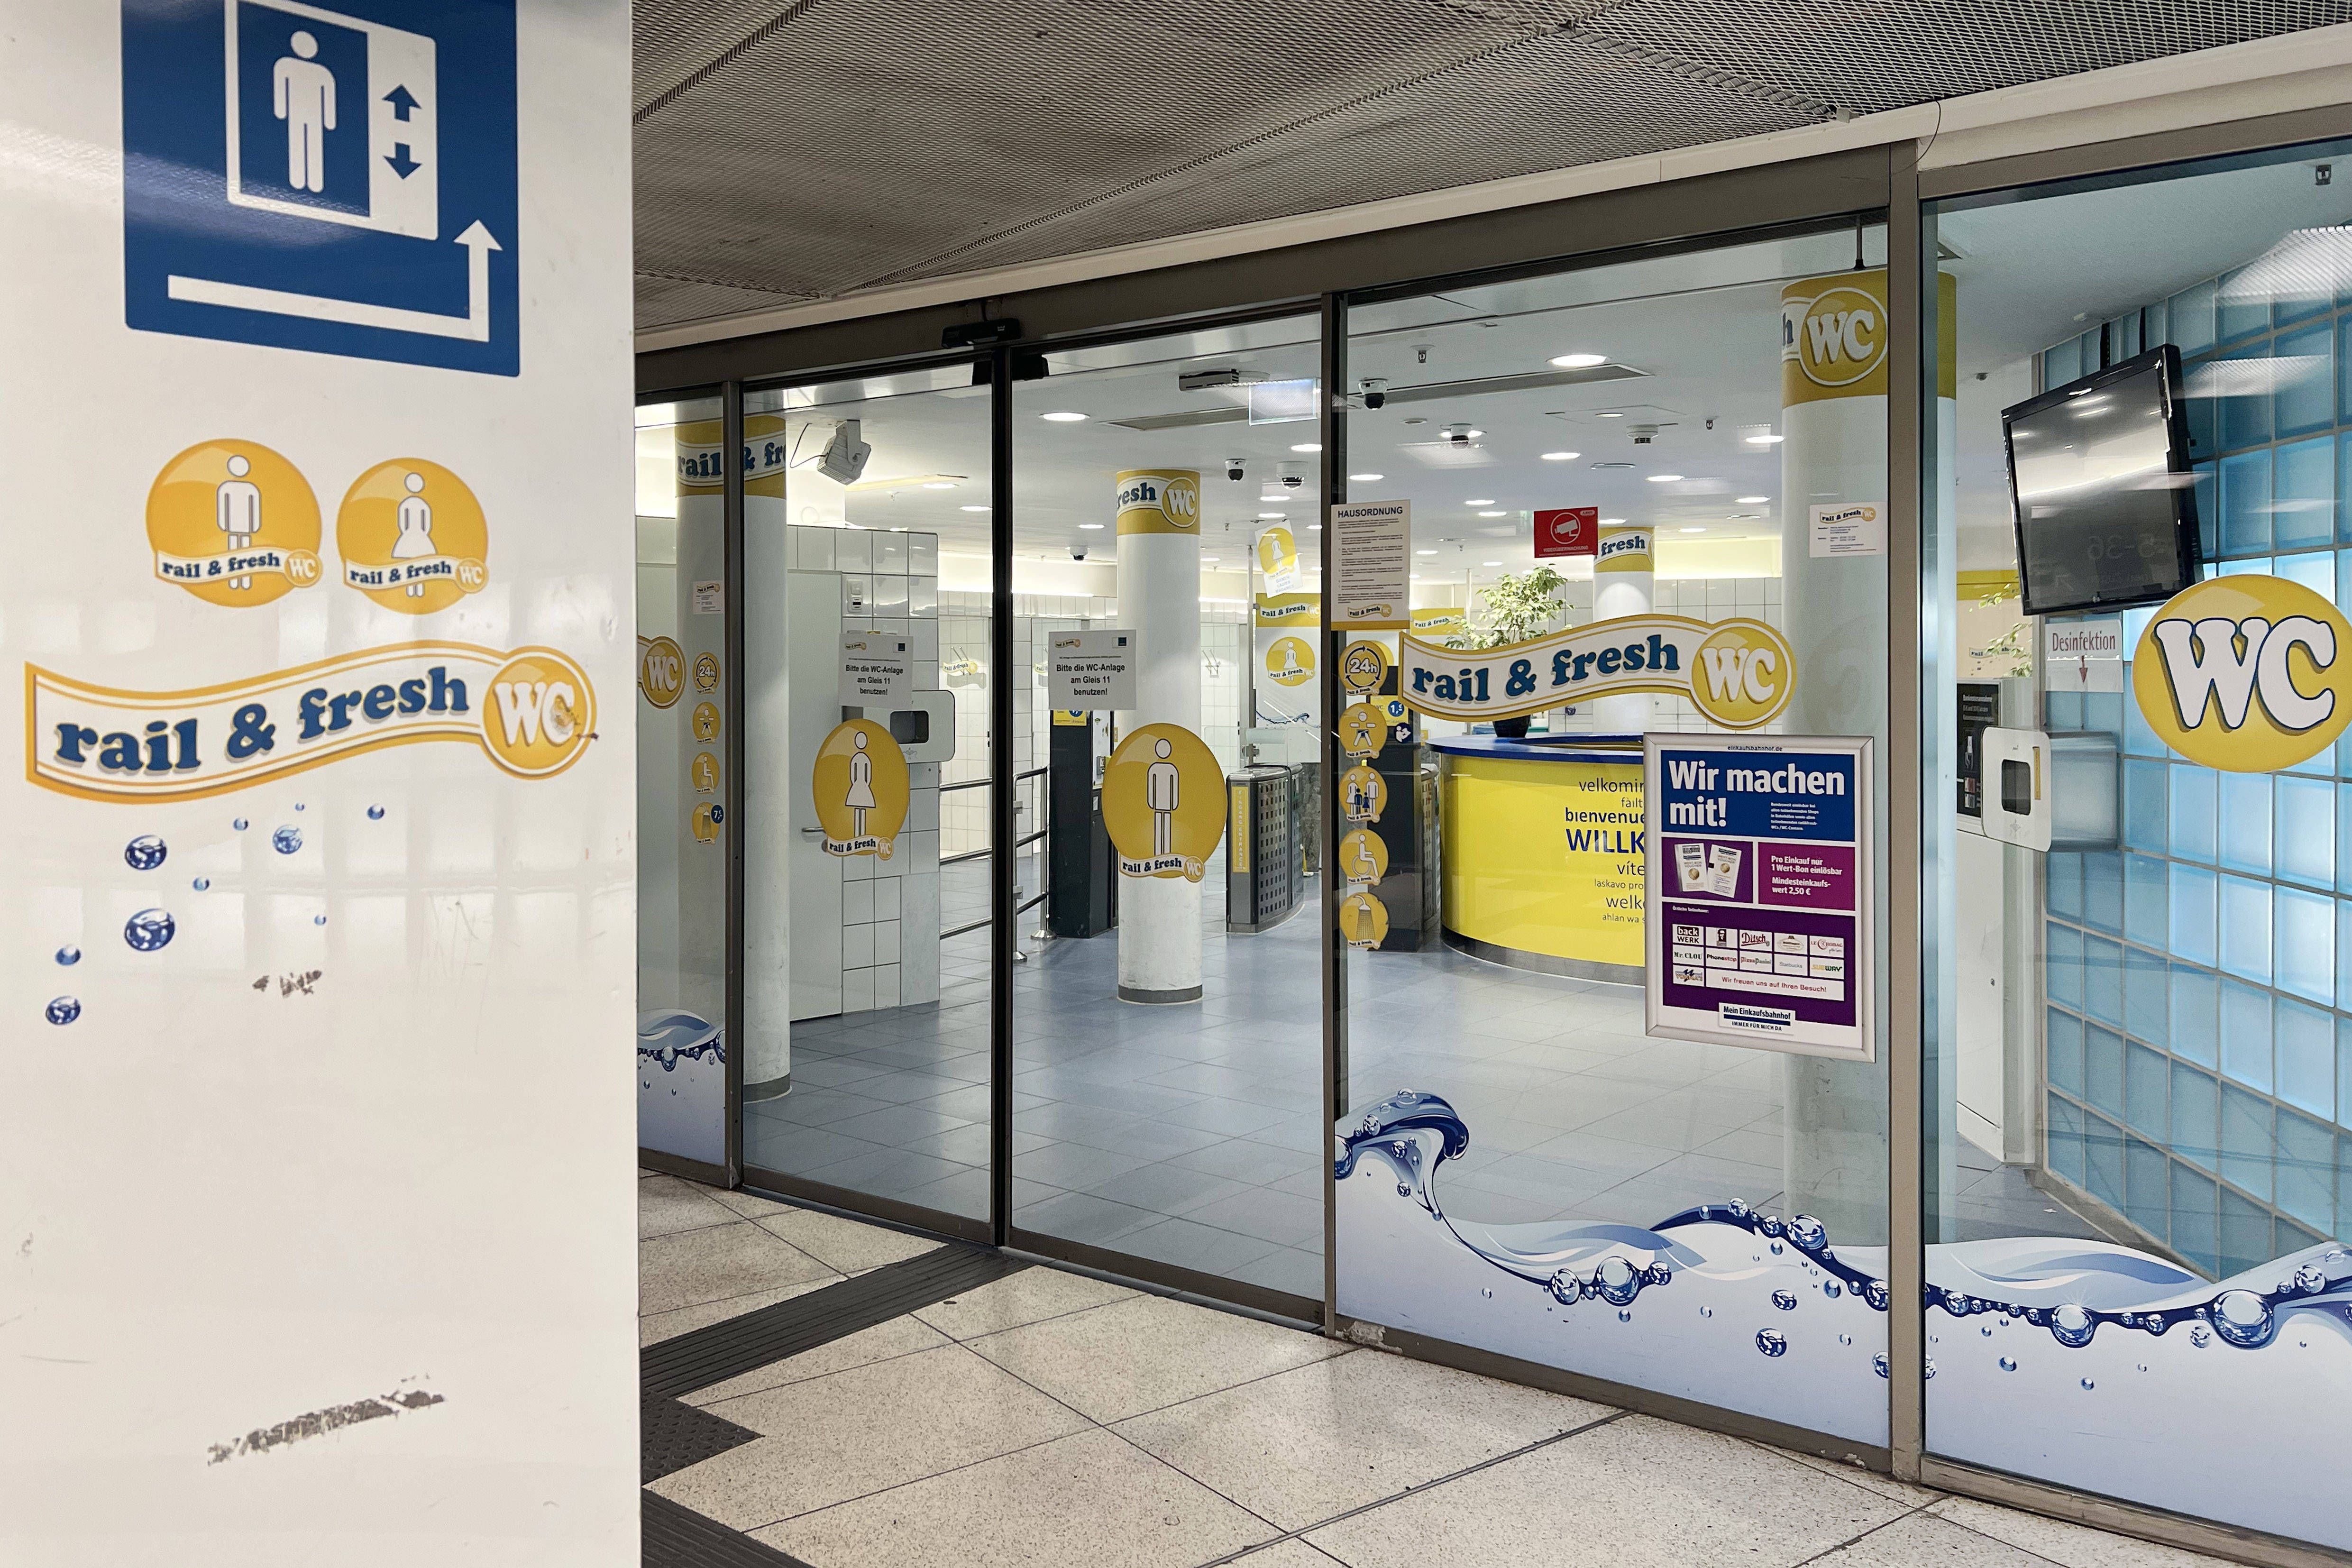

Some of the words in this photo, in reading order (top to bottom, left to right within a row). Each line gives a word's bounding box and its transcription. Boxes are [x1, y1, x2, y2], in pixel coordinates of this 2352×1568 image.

[1807, 310, 1874, 367] WC
[677, 452, 723, 478] rail
[764, 442, 786, 467] fr
[1167, 489, 1195, 516] WC
[1337, 506, 1403, 518] HAUSORDNUNG
[1843, 510, 1861, 518] fresh
[1601, 536, 1646, 556] fresh
[163, 560, 201, 578] rail
[208, 559, 221, 574] &
[228, 553, 281, 572] fresh
[287, 557, 317, 578] WC
[349, 569, 383, 586] rail
[389, 567, 402, 582] &
[406, 561, 452, 578] fresh
[458, 564, 484, 586] WC
[1286, 605, 1306, 614] fresh
[1309, 607, 1320, 615] WC
[2052, 632, 2116, 652] Desinfektion
[699, 665, 715, 677] 24h
[846, 664, 859, 673] Bitte
[860, 665, 869, 673] die
[870, 665, 904, 675] WC-Anlage
[1056, 664, 1072, 672] Bitte
[1086, 663, 1125, 673] WC-Anlage
[1350, 657, 1378, 674] 24h
[1413, 666, 1491, 703] rail
[1505, 658, 1537, 698] &
[1551, 634, 1681, 687] fresh
[1700, 647, 1775, 704] WC
[647, 655, 678, 692] WC
[867, 676, 882, 684] Gleis
[1083, 676, 1100, 684] Gleis
[2153, 615, 2336, 733] WC
[860, 687, 888, 696] benutzen!
[1073, 688, 1107, 696] benutzen!
[55, 718, 202, 774] rail
[224, 703, 277, 761] &
[297, 666, 469, 742] fresh
[495, 681, 576, 748] WC
[1668, 760, 1719, 790] Wir
[1727, 763, 1845, 795] machen
[1670, 796, 1727, 827] mit!
[829, 843, 843, 853] rail
[846, 842, 852, 851] &
[854, 838, 876, 851] fresh
[879, 842, 891, 855] WC
[1566, 828, 1644, 853] WILLK
[1122, 861, 1141, 873] rail
[1144, 860, 1151, 871] &
[1154, 858, 1182, 870] fresh
[1186, 862, 1202, 876] WC
[1771, 855, 1784, 863] Pro
[1785, 856, 1810, 865] Einkauf
[1617, 861, 1645, 876] víte
[1776, 864, 1809, 874] Wert-Bon
[1810, 866, 1842, 875] einlösbar
[1594, 879, 1626, 889] laskavo
[1772, 877, 1831, 888] Mindesteinkaufs-
[1789, 887, 1804, 895] 2,50
[1805, 888, 1811, 896] €
[1606, 894, 1645, 910] welk
[1602, 913, 1624, 922] ahlan
[1678, 926, 1698, 936] back
[1741, 932, 1766, 944] Ditsch
[1677, 936, 1700, 944] WERK
[1707, 954, 1737, 962] Phonestop
[1733, 977, 1754, 986] freuen
[1800, 984, 1827, 992] Besuch!
[1723, 1006, 1738, 1014] Mein
[1739, 1007, 1791, 1020] Einkaufsbahnhof
